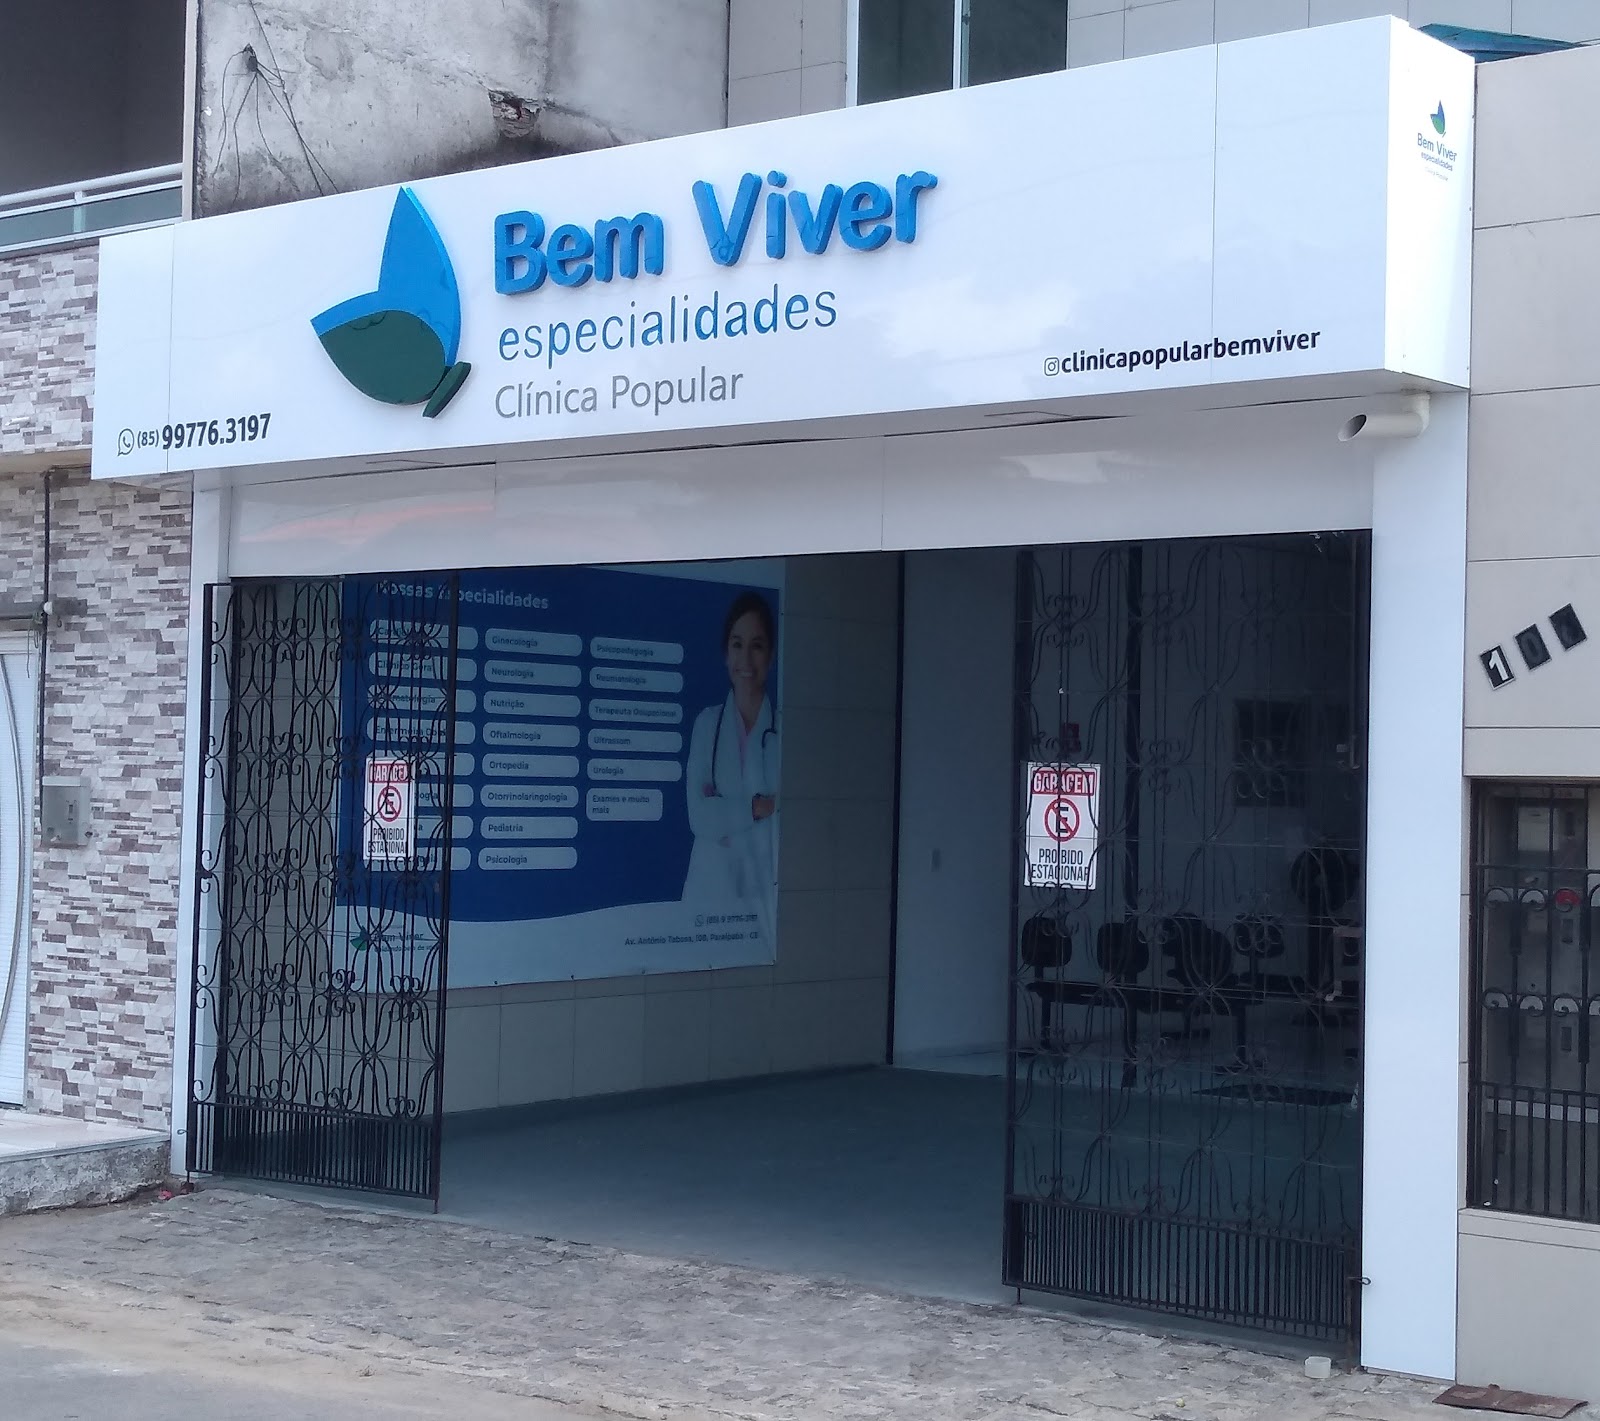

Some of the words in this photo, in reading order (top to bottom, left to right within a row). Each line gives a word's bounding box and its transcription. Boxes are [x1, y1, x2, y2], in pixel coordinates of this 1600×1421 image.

[1418, 132, 1434, 152] Bem
[493, 210, 667, 296] Bem
[692, 170, 938, 268] Viver
[497, 283, 838, 369] especialidades
[1061, 329, 1321, 373] clinicapopularbemviver
[494, 381, 598, 419] Clínica
[611, 365, 744, 417] Popular
[137, 428, 160, 448] (85)
[162, 412, 271, 450] 99776.3197
[438, 585, 550, 609] pecialidades
[491, 636, 538, 648] Ginecologia
[491, 667, 534, 679] Neurologia
[490, 698, 525, 709] Nutrição
[595, 706, 632, 716] Terapeuta
[489, 729, 542, 742] Oftalmologia
[489, 760, 529, 771] Ortopedia
[593, 766, 624, 776] Urologia
[487, 792, 568, 803] Otorrinolaringologia
[592, 794, 620, 803] Exames
[628, 795, 650, 803] muito
[592, 805, 610, 814] mais
[488, 823, 524, 832] Pediatria
[373, 827, 405, 841] PROIBIDO
[368, 841, 408, 854] ESTAIONA
[485, 855, 528, 866] Psicologia
[1038, 848, 1084, 866] PROBIDO
